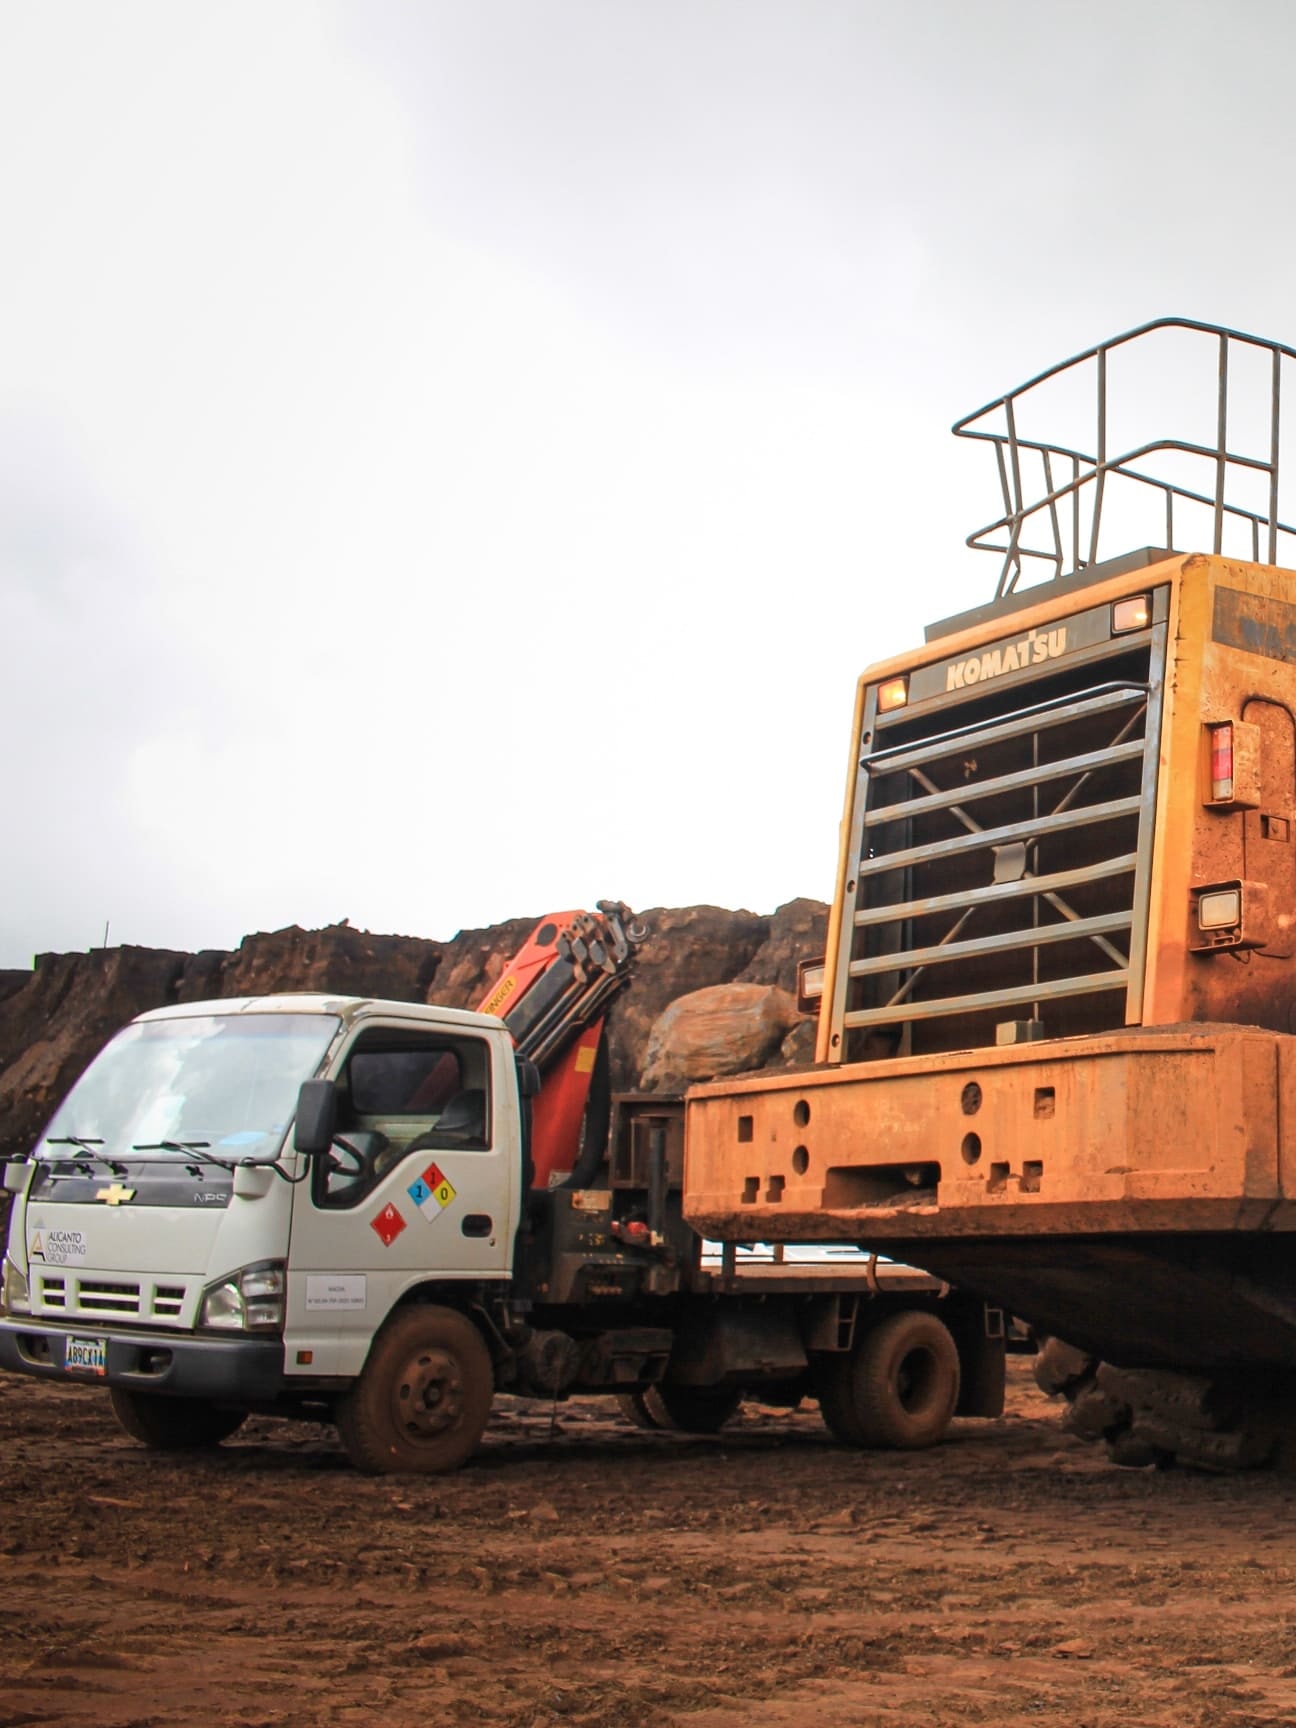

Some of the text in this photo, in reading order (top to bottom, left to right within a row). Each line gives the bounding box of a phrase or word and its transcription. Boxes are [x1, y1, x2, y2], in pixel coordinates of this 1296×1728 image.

[946, 627, 1066, 691] KOMATSU
[430, 1172, 436, 1184] 1
[416, 1185, 422, 1198] 1
[440, 1187, 448, 1200] 0
[49, 1231, 82, 1244] ALICANTO
[48, 1242, 86, 1255] CONSULTING
[46, 1252, 68, 1264] GROUP
